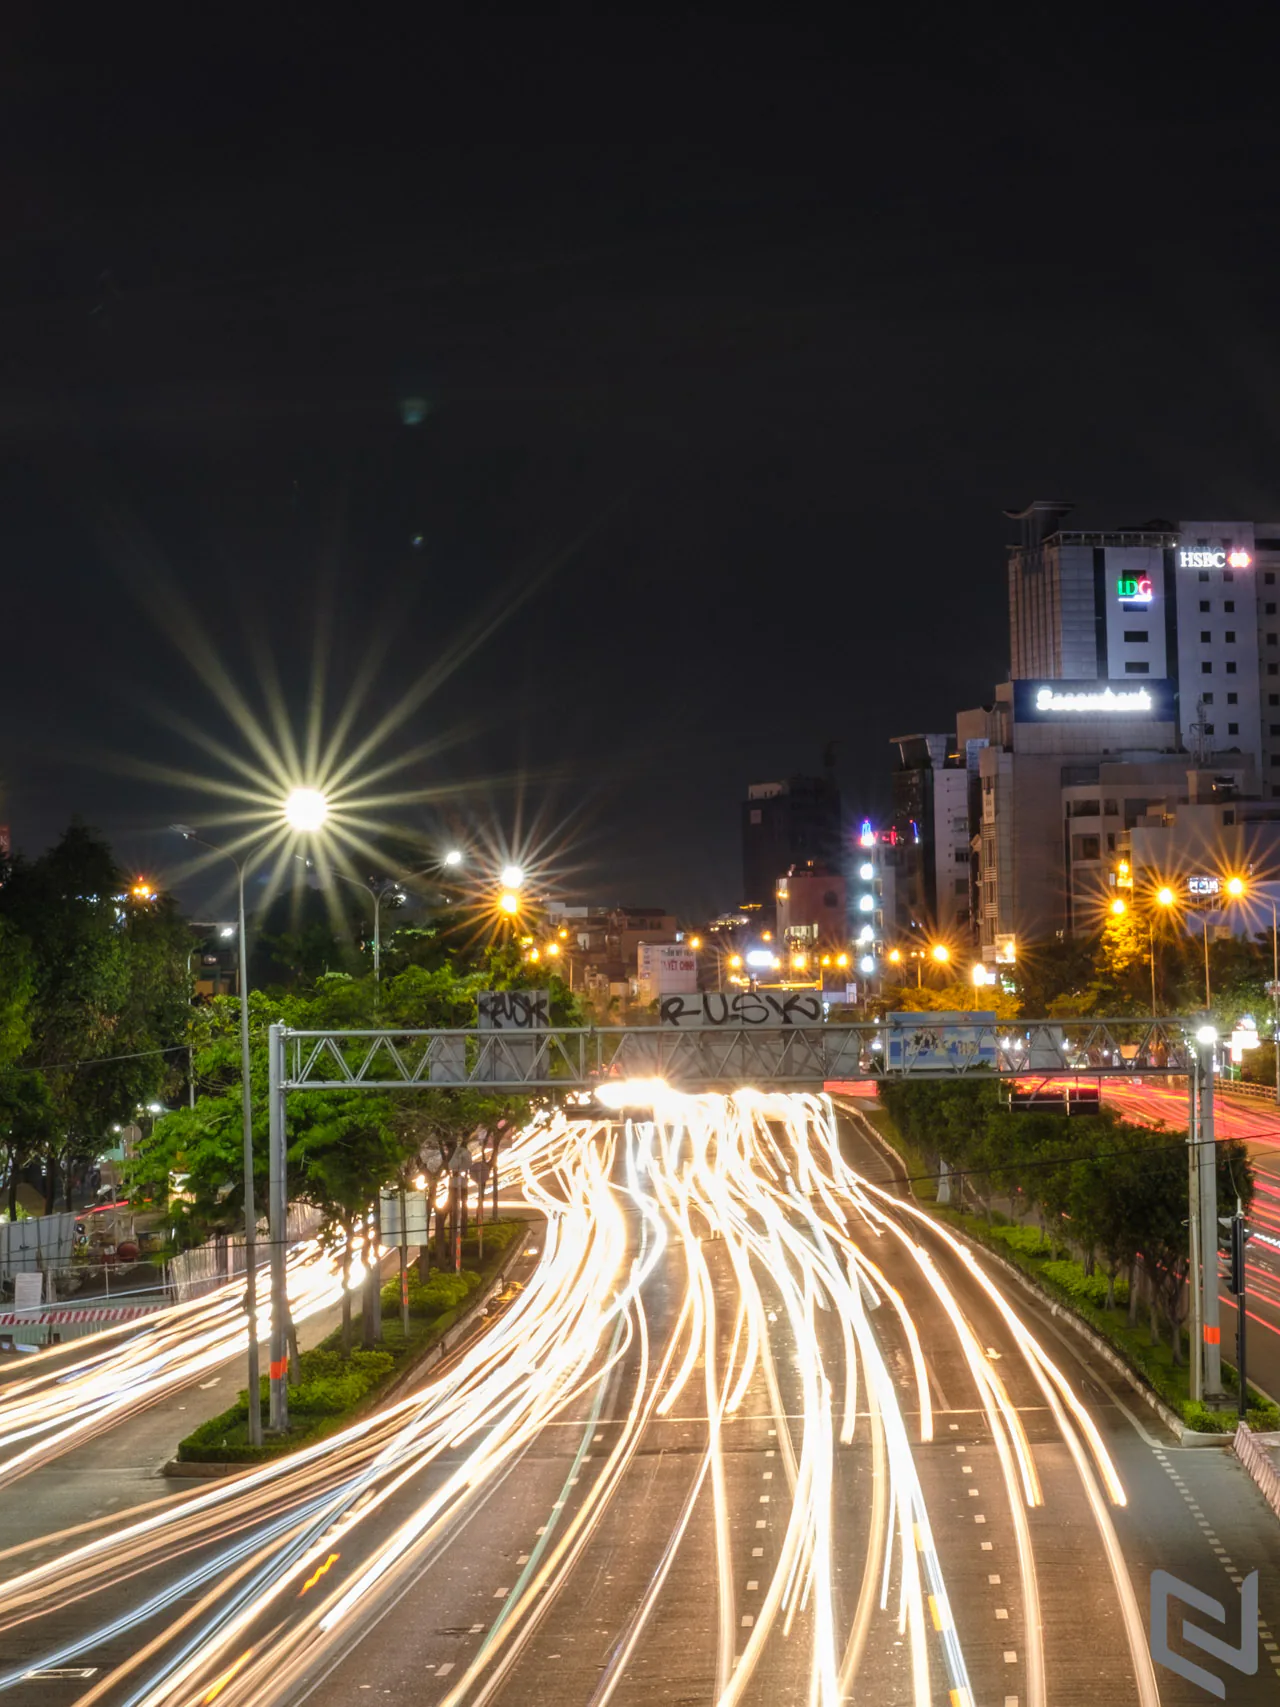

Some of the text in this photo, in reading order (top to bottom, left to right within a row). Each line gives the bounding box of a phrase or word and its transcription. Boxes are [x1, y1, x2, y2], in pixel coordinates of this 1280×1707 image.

[1180, 552, 1226, 568] HSBC
[1117, 580, 1153, 596] LDG
[660, 992, 821, 1026] RUSK
